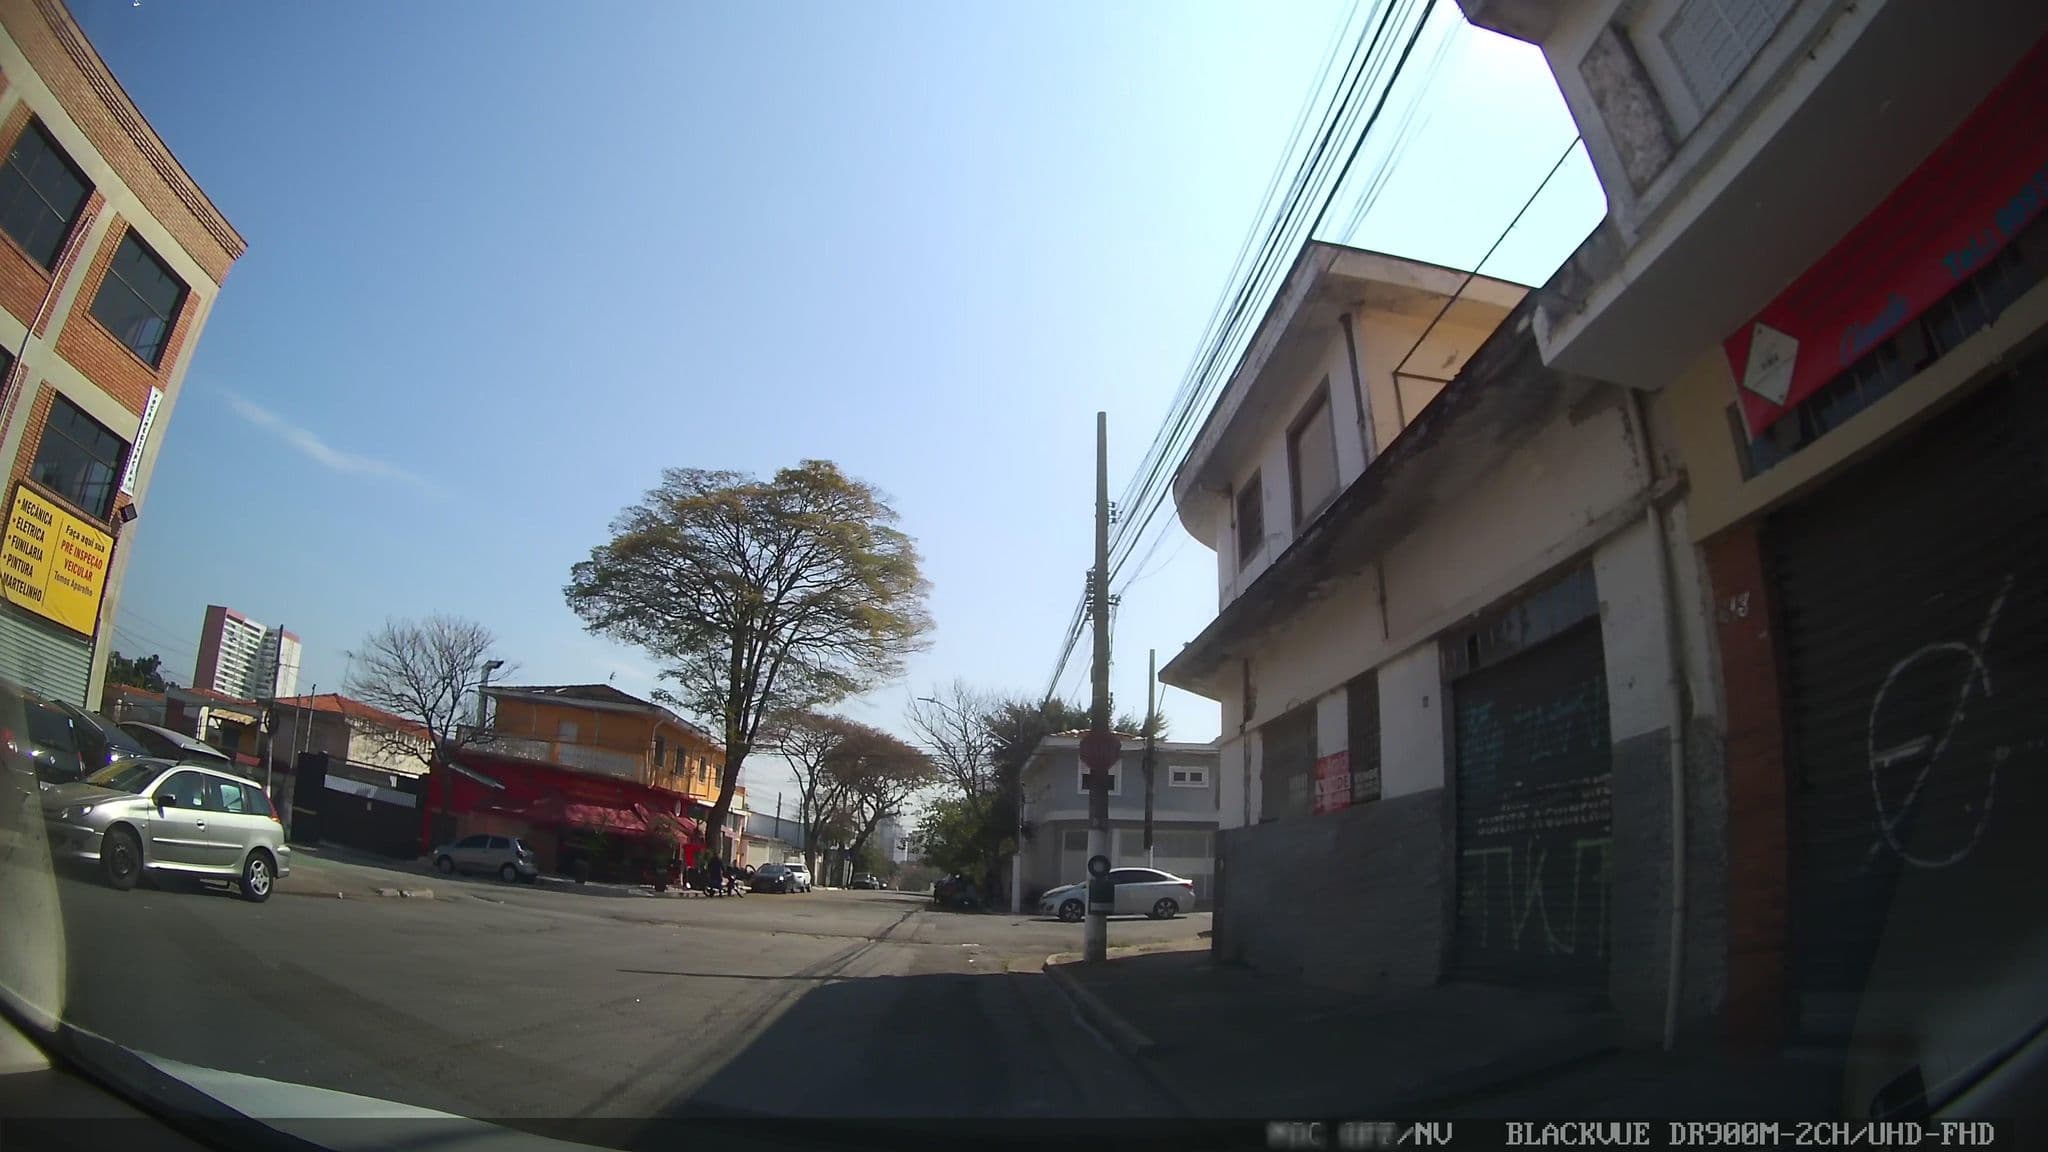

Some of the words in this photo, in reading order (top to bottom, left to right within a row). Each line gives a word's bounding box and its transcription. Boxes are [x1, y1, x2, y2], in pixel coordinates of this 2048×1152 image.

[11, 535, 43, 562] FUNILARIA
[65, 525, 81, 540] Faça
[81, 535, 94, 548] aqui
[6, 554, 34, 578] PINTURA
[64, 558, 93, 582] VEICULAR
[3, 572, 42, 602] MARTELINHO
